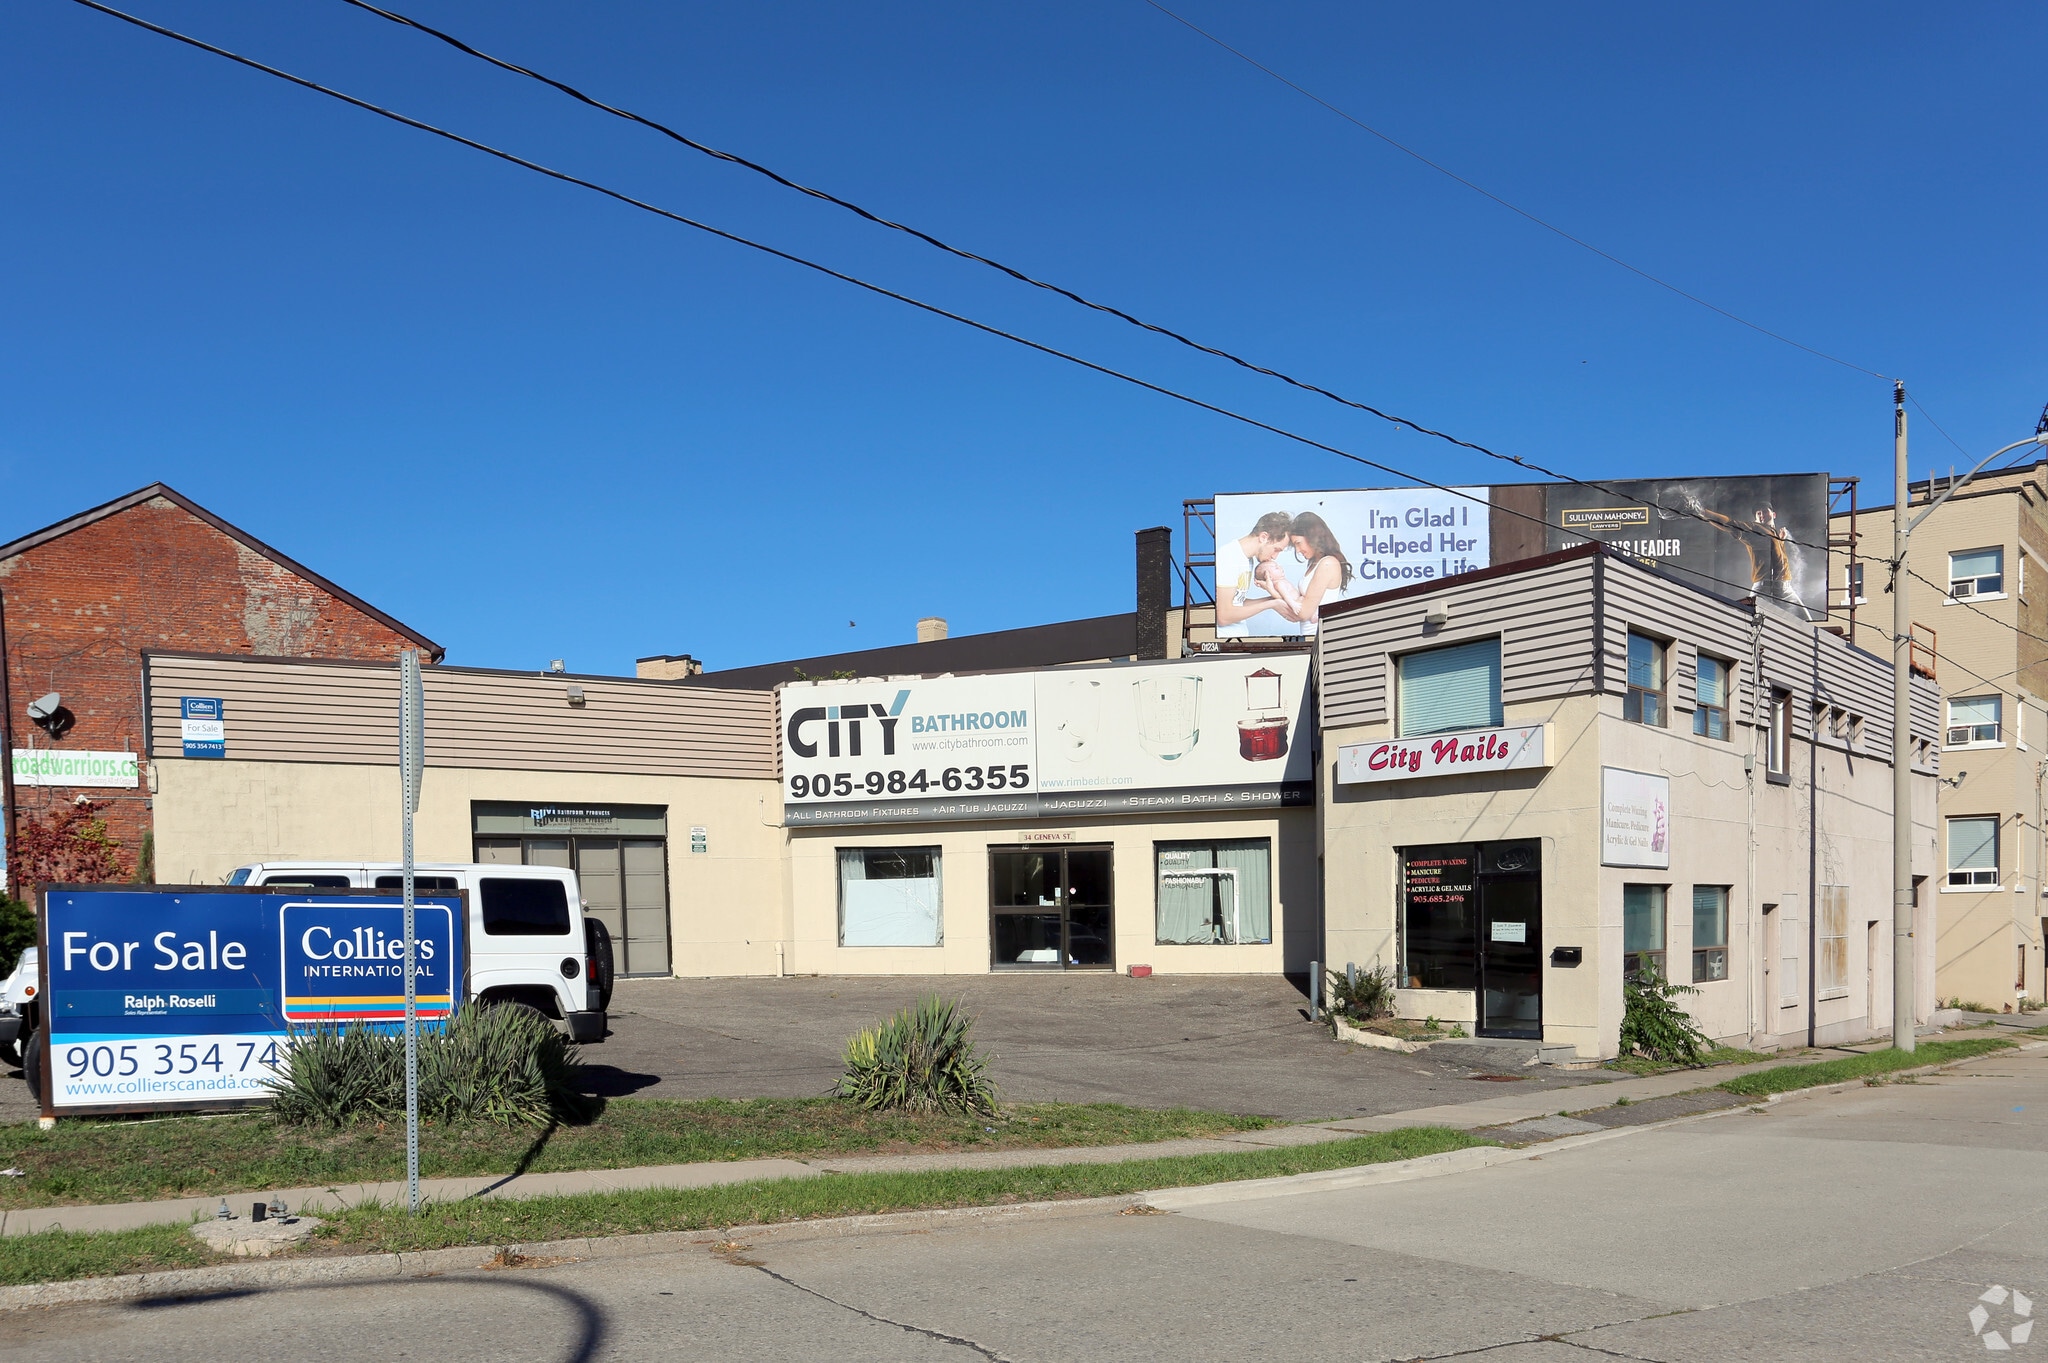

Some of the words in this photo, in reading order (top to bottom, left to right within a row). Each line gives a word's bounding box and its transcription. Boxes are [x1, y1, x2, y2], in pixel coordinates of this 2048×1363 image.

[1369, 508, 1398, 529] I'm
[1405, 506, 1455, 528] Glad
[1462, 506, 1468, 526] I
[1568, 513, 1603, 522] SULLIVAN
[1604, 511, 1642, 521] MAHONEY
[1361, 532, 1433, 558] Helped
[1440, 531, 1478, 552] Her
[1633, 538, 1681, 558] LEADER
[1359, 558, 1434, 580] Choose
[1441, 556, 1479, 578] Life
[1201, 642, 1219, 652] 0123A
[187, 723, 200, 732] For
[202, 724, 219, 733] Sale
[911, 710, 1028, 734] BATHROOM
[912, 735, 1029, 752] www.citybathroom.com
[1368, 745, 1422, 772] City
[1431, 734, 1509, 764] Nails
[12, 751, 138, 777] roadwarriors.ca
[790, 763, 1031, 799] 905-984-6355
[815, 809, 869, 819] BATHROOM
[872, 806, 919, 817] FIXTURES
[959, 803, 980, 813] TUB
[983, 802, 1028, 813] JACUZZI
[1181, 793, 1218, 805] BATH
[1223, 792, 1235, 803] &
[1241, 790, 1302, 801] SHOWER
[1607, 801, 1631, 816] Complete
[1034, 833, 1060, 841] GENEVA
[1062, 832, 1073, 840] ST.
[1164, 852, 1191, 860] QUALITY
[1411, 860, 1442, 868] COMPLETE
[1442, 858, 1467, 866] WAXING
[1411, 868, 1442, 876] MANICURE
[1411, 885, 1435, 893] ACRYLIC
[1453, 884, 1472, 892] NAILS
[1413, 894, 1465, 903] 905.685.2496
[63, 931, 139, 971] For
[153, 929, 247, 971] Sale
[301, 925, 435, 960] Collies
[303, 965, 435, 977] INTERNATIOAL
[124, 994, 165, 1012] Ralph
[169, 994, 216, 1009] Roselli
[66, 1045, 138, 1078] 905
[154, 1043, 224, 1074] 354
[237, 1041, 297, 1072] 74
